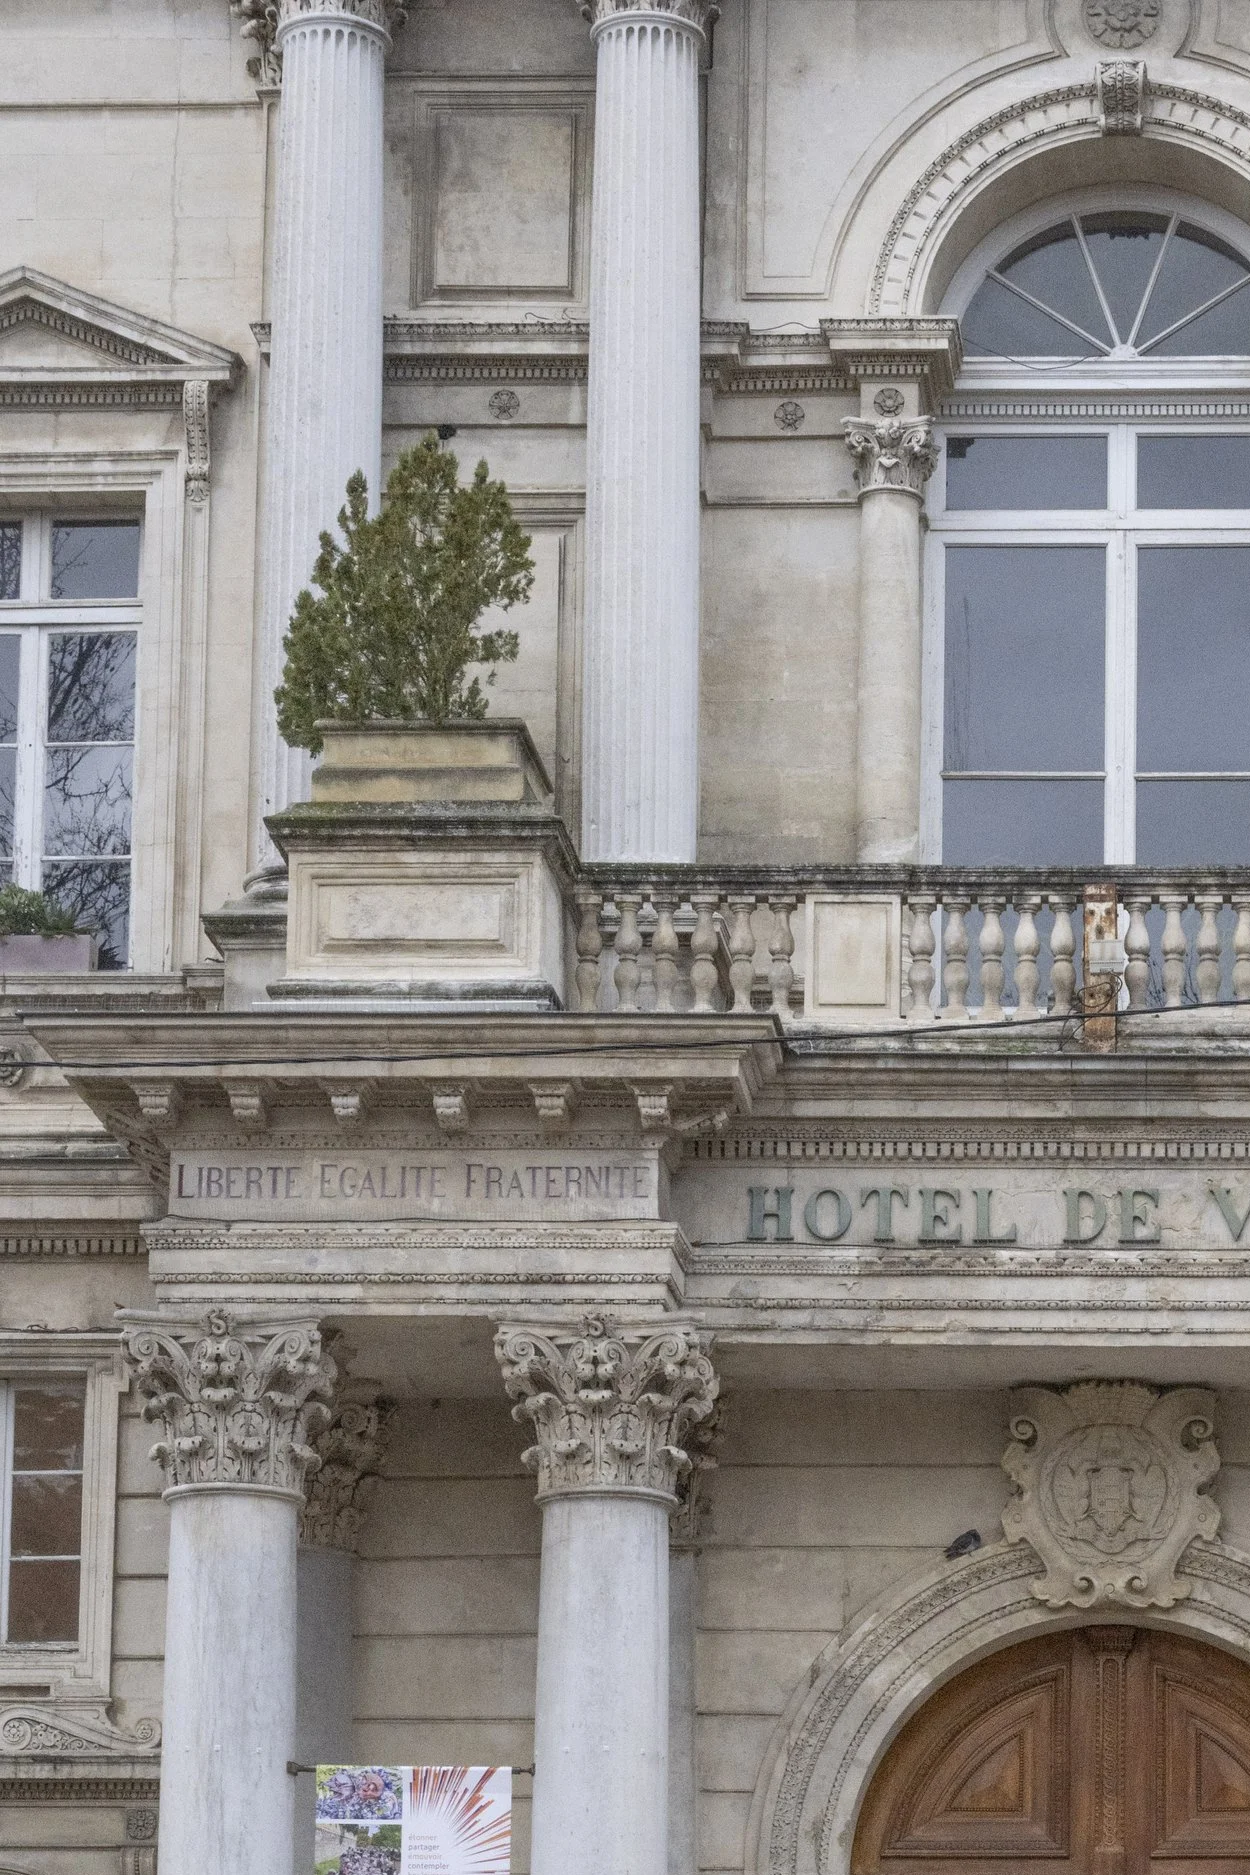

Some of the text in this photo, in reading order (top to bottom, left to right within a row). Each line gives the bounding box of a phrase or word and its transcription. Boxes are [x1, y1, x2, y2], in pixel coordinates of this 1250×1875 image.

[176, 1163, 650, 1200] LIBERTE EGALITE FRATERNITE
[746, 1184, 1018, 1244] HOTEL
[1062, 1186, 1164, 1245] DE
[408, 1833, 437, 1841] étonner
